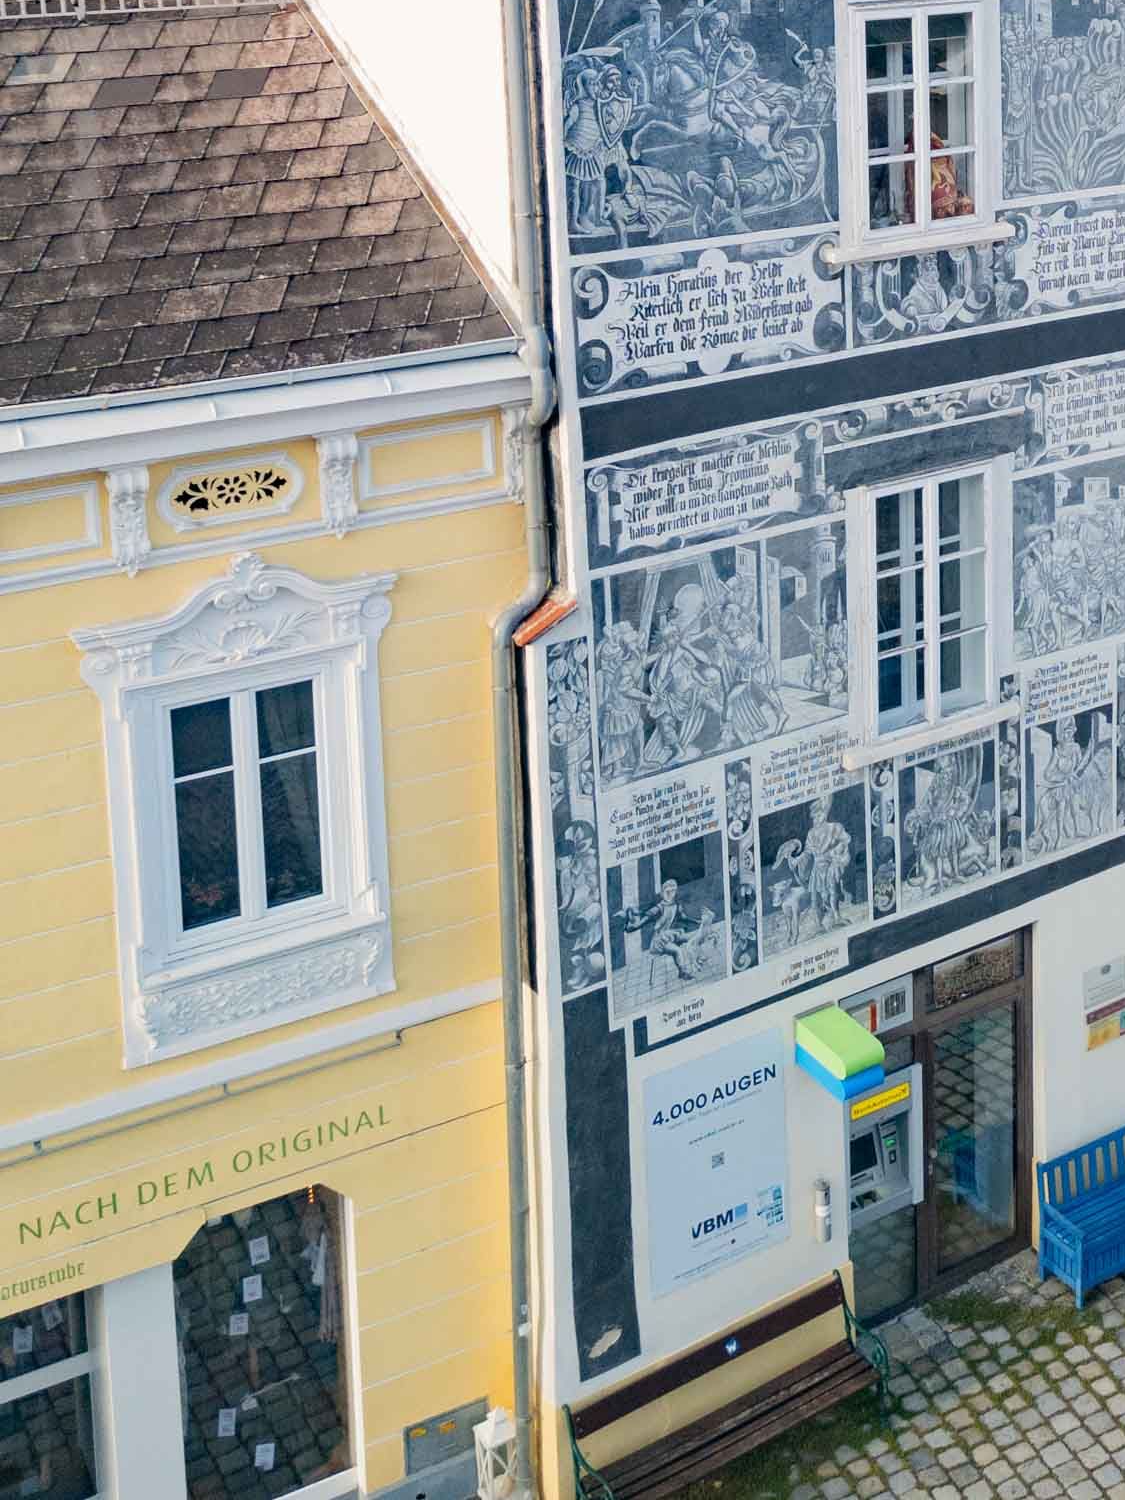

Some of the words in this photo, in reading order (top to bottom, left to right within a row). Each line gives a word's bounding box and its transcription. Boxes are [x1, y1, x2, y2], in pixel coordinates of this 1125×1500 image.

[651, 1092, 708, 1127] 4.000
[711, 1063, 777, 1103] AUGEN
[18, 1192, 119, 1245] NACH
[136, 1160, 215, 1206] DEM
[231, 1105, 393, 1174] ORIGINAL
[691, 1207, 734, 1240] VBM
